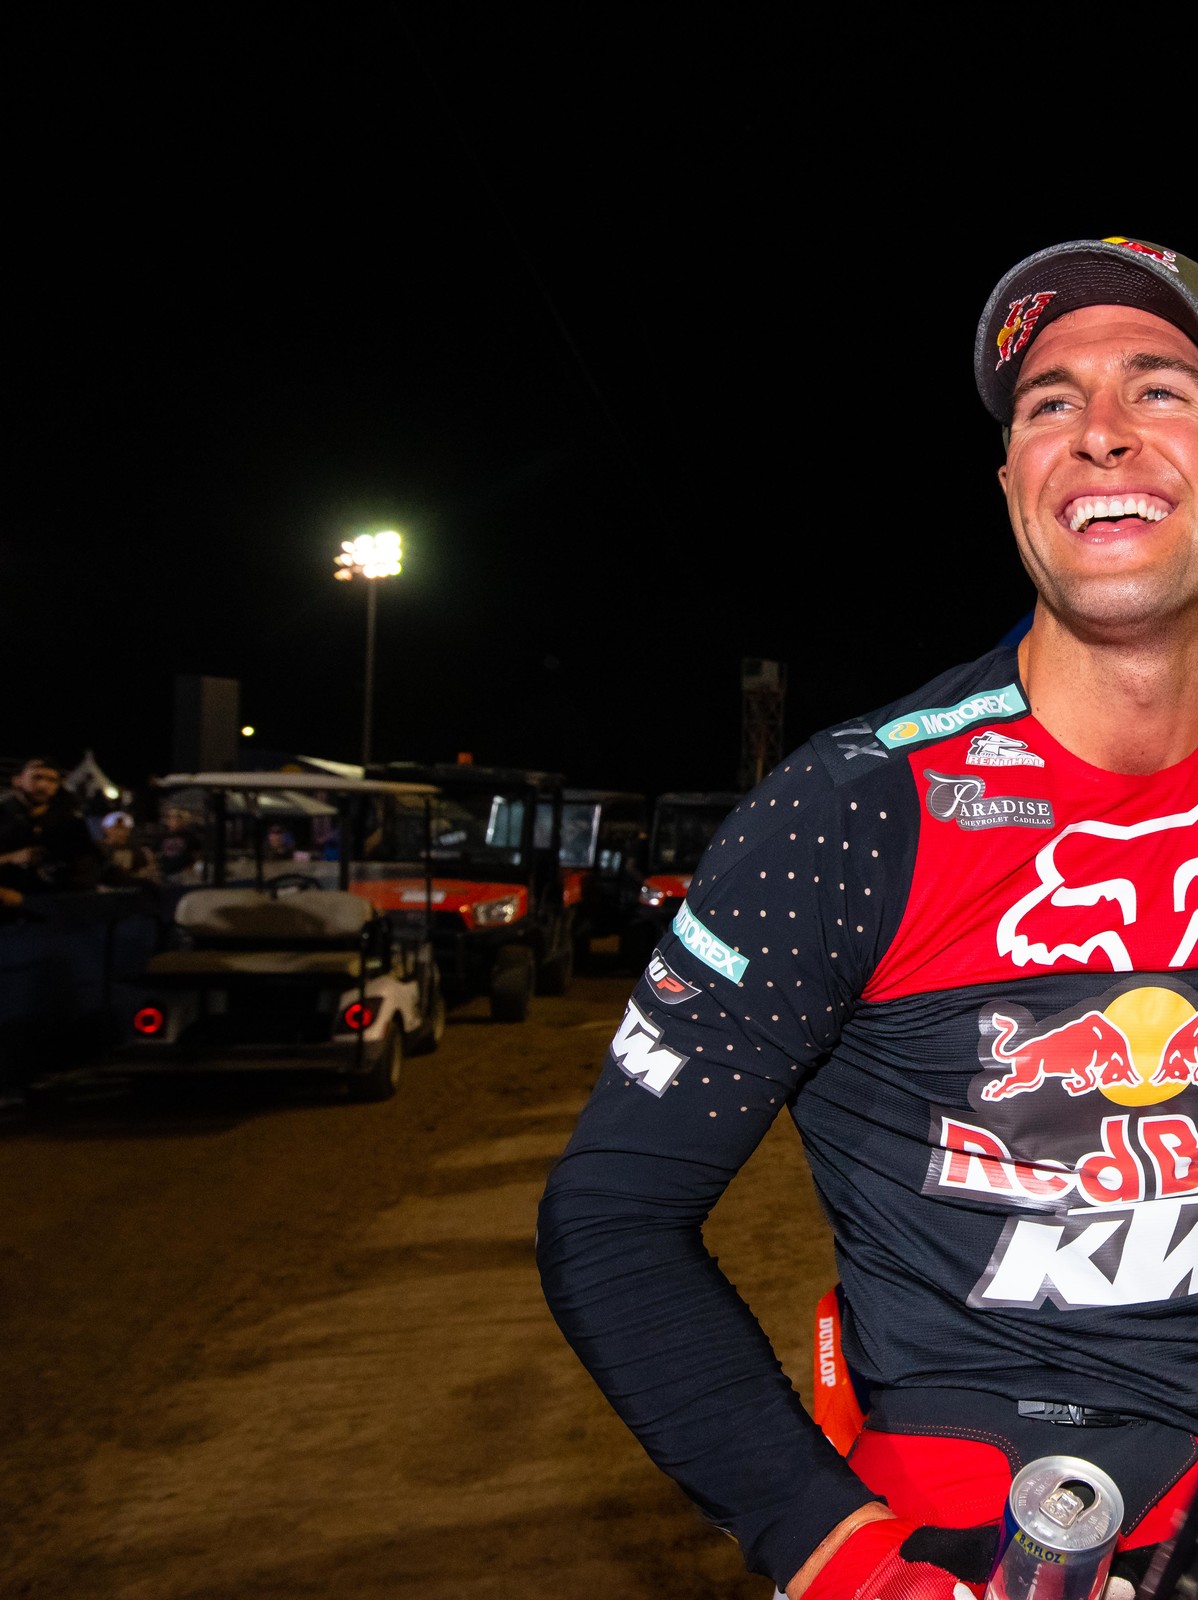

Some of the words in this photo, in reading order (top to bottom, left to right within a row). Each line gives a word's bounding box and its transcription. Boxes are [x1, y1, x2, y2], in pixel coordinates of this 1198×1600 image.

[920, 693, 1013, 735] MOTOREX
[968, 756, 1044, 768] RENTHAL
[928, 773, 1050, 818] PARADISE
[960, 816, 1009, 827] CHEVROLET
[1013, 815, 1051, 826] CADILLAC
[676, 902, 740, 977] OTOREX
[612, 998, 682, 1093] TM
[938, 1114, 1145, 1207] Red
[819, 1317, 836, 1388] DUNLOP
[1019, 1534, 1034, 1552] 8.4
[1034, 1547, 1044, 1558] FL
[1044, 1550, 1062, 1564] OZ
